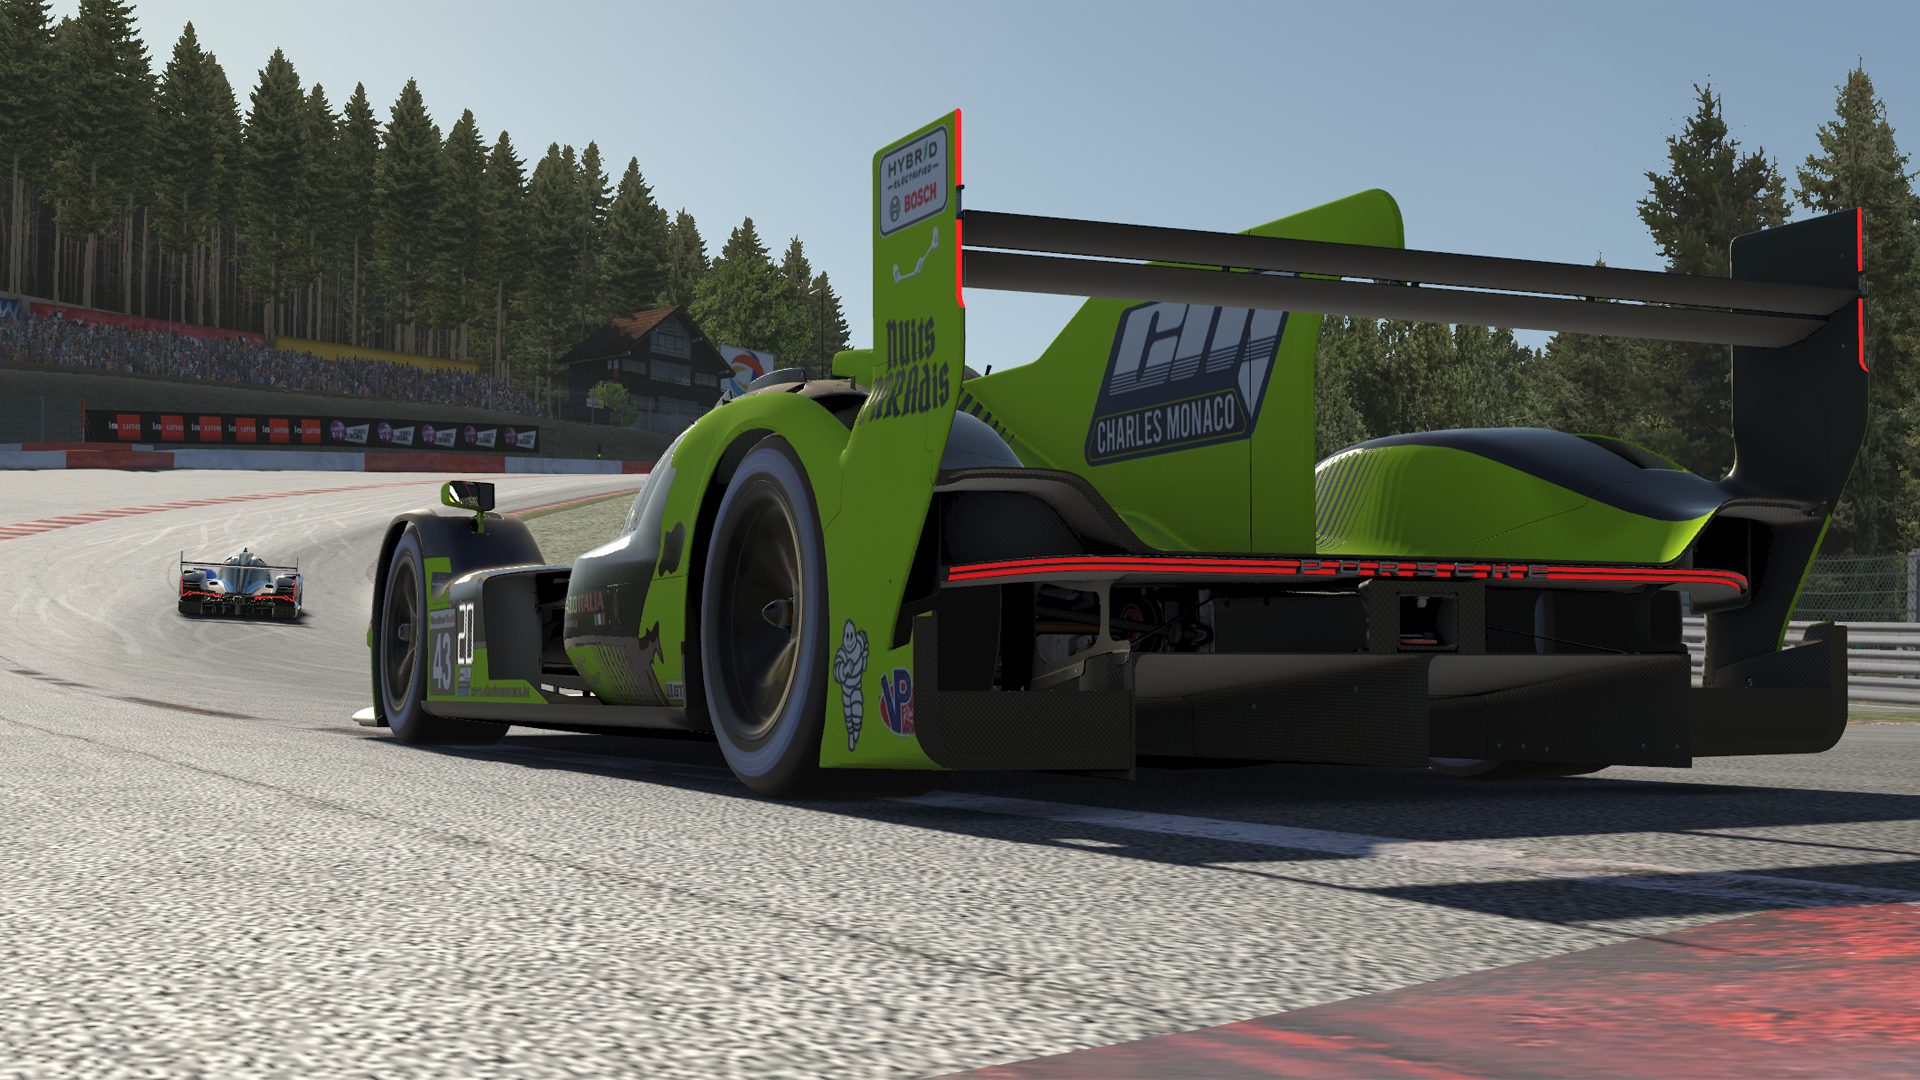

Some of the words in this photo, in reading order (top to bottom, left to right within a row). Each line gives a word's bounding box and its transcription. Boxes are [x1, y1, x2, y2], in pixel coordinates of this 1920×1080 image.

[887, 141, 938, 179] HYBRID
[904, 182, 937, 214] BOSCH
[1097, 408, 1163, 454] CHARLES
[1166, 393, 1236, 442] MONACO
[1299, 558, 1551, 581] PORSCHE
[433, 632, 451, 690] 43
[457, 603, 474, 665] 20
[881, 668, 912, 734] VP
